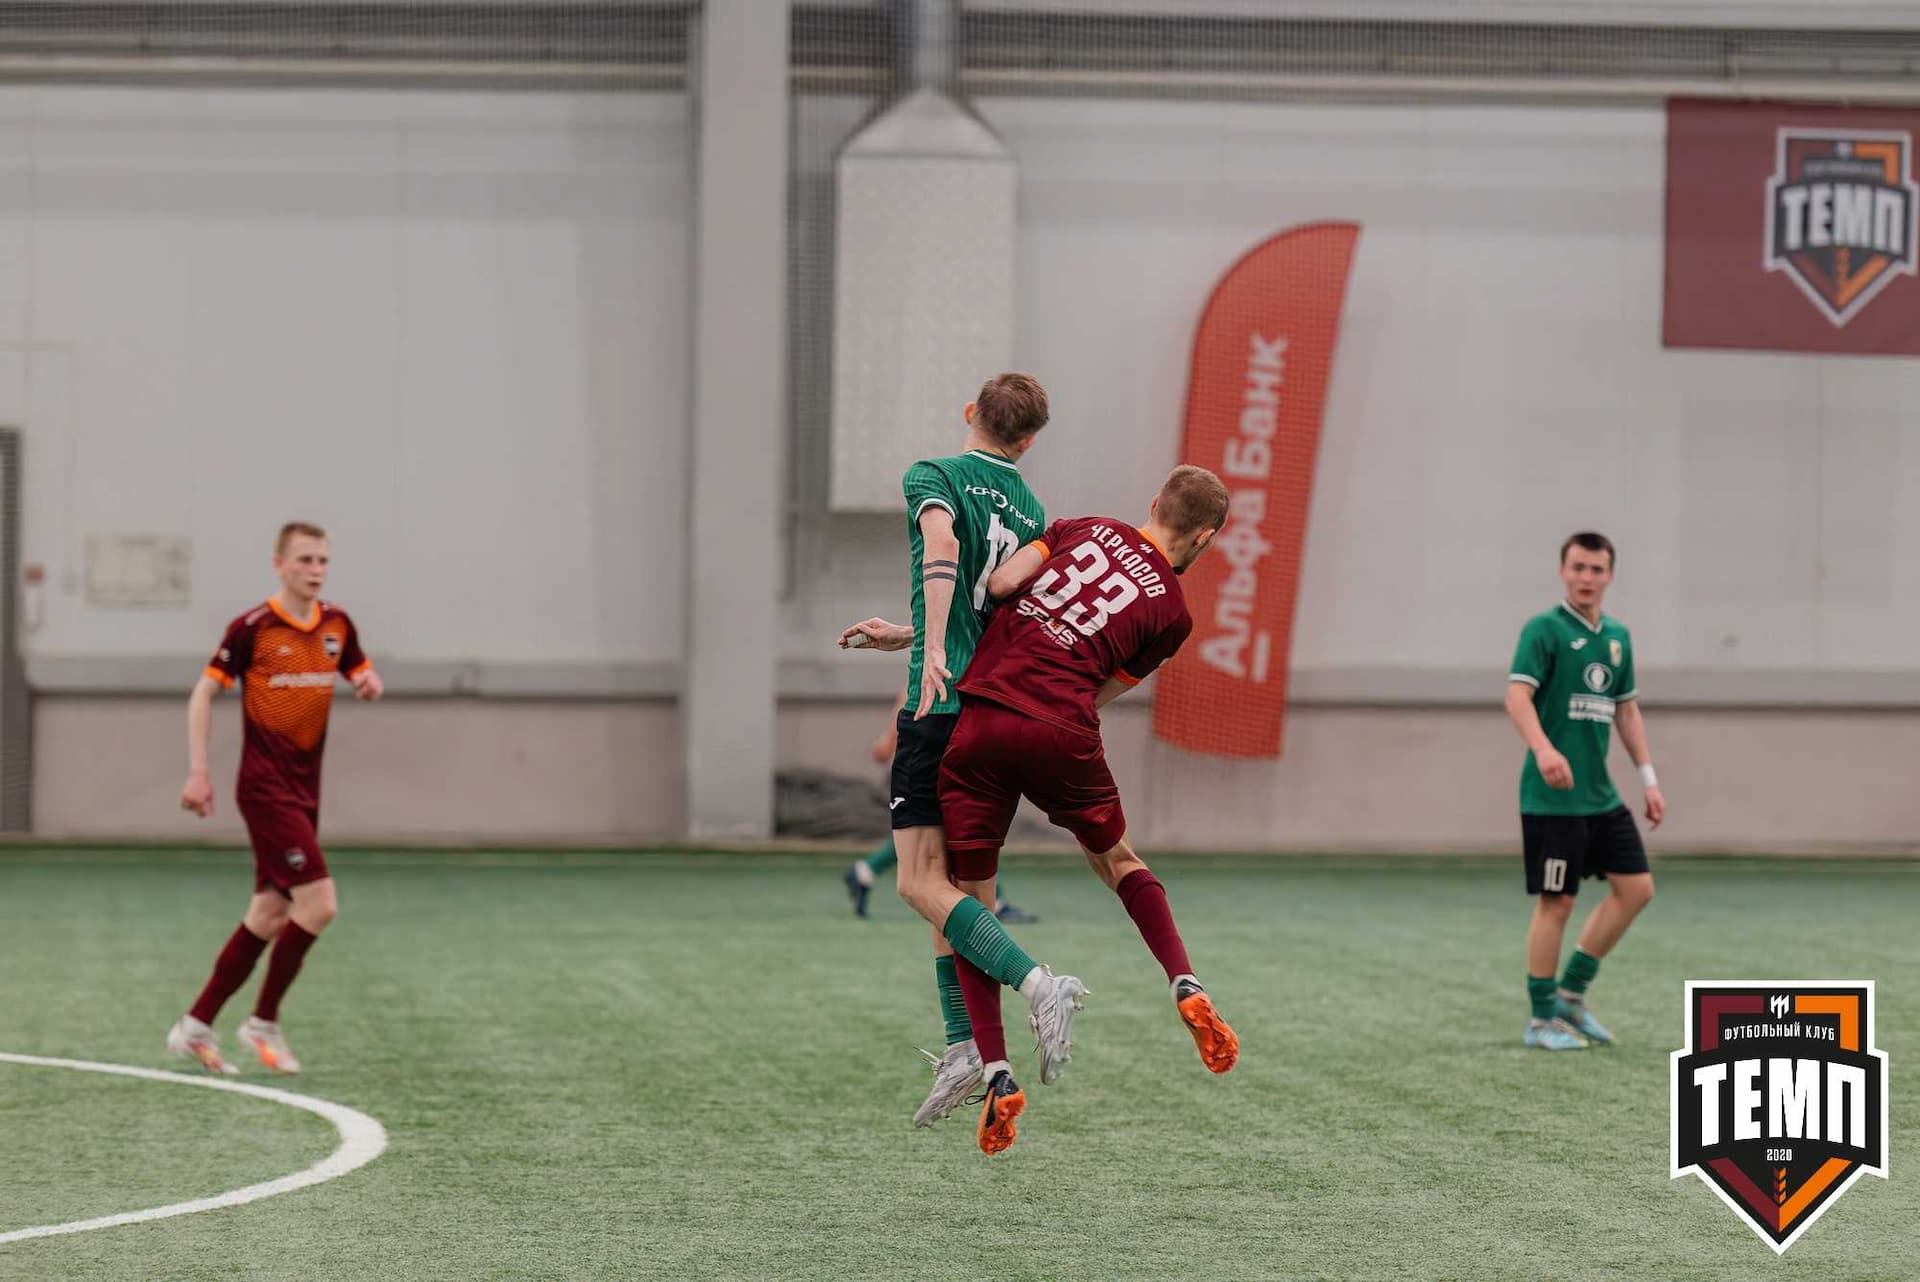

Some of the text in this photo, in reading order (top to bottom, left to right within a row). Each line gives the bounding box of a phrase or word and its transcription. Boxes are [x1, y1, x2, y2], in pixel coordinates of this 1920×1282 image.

[1781, 182, 1906, 254] ТЕМП
[1200, 334, 1288, 679] Альфа Банк
[1030, 540, 1139, 637] 33
[1091, 524, 1166, 599] ЧЕРКАСОВ
[1543, 857, 1567, 892] 10
